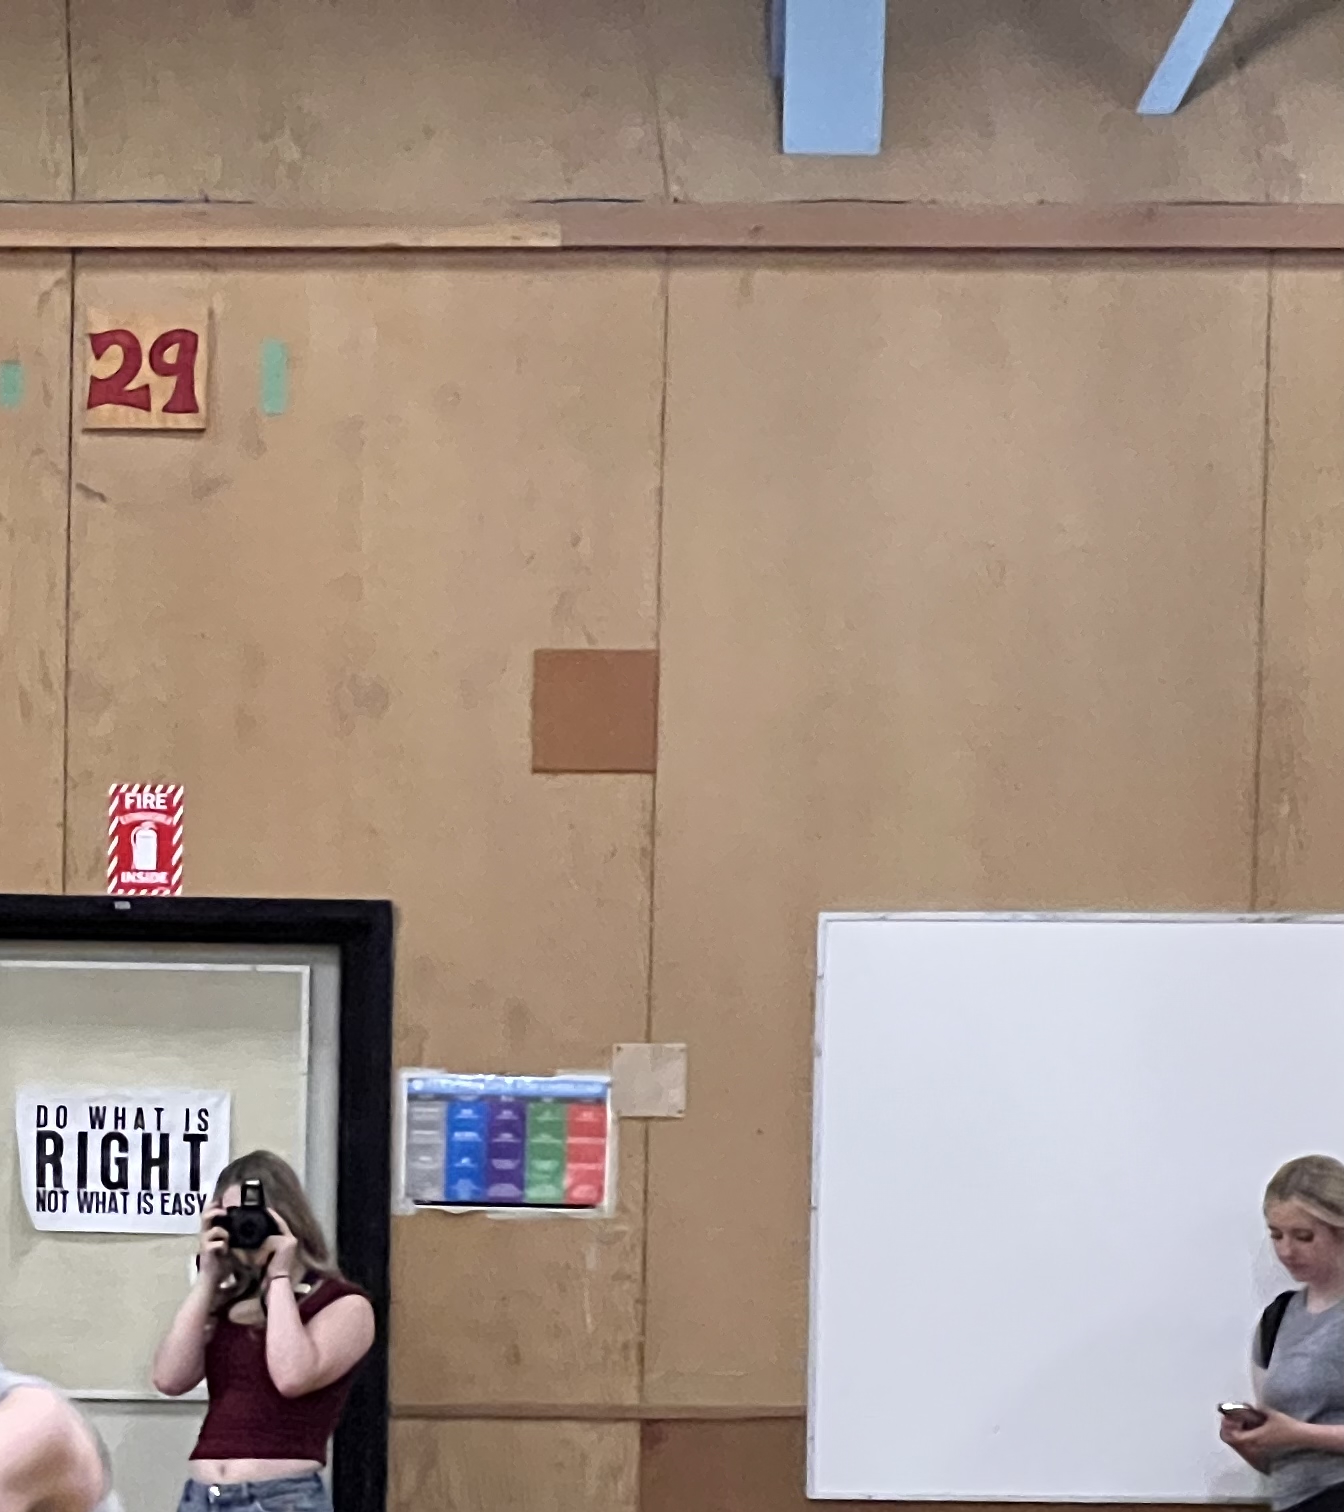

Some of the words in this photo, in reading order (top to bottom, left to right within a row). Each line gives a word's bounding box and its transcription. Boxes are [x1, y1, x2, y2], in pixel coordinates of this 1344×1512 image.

[87, 328, 200, 414] 29
[124, 792, 168, 810] FIRE
[120, 872, 169, 884] INSIDE
[36, 1104, 68, 1129] DO
[88, 1105, 165, 1131] WHAT
[184, 1107, 210, 1132] IS
[35, 1130, 210, 1192] RIGHT
[35, 1189, 70, 1213] NOT
[77, 1191, 130, 1214] WHAT
[137, 1191, 154, 1215] IS
[160, 1193, 208, 1216] EASY
